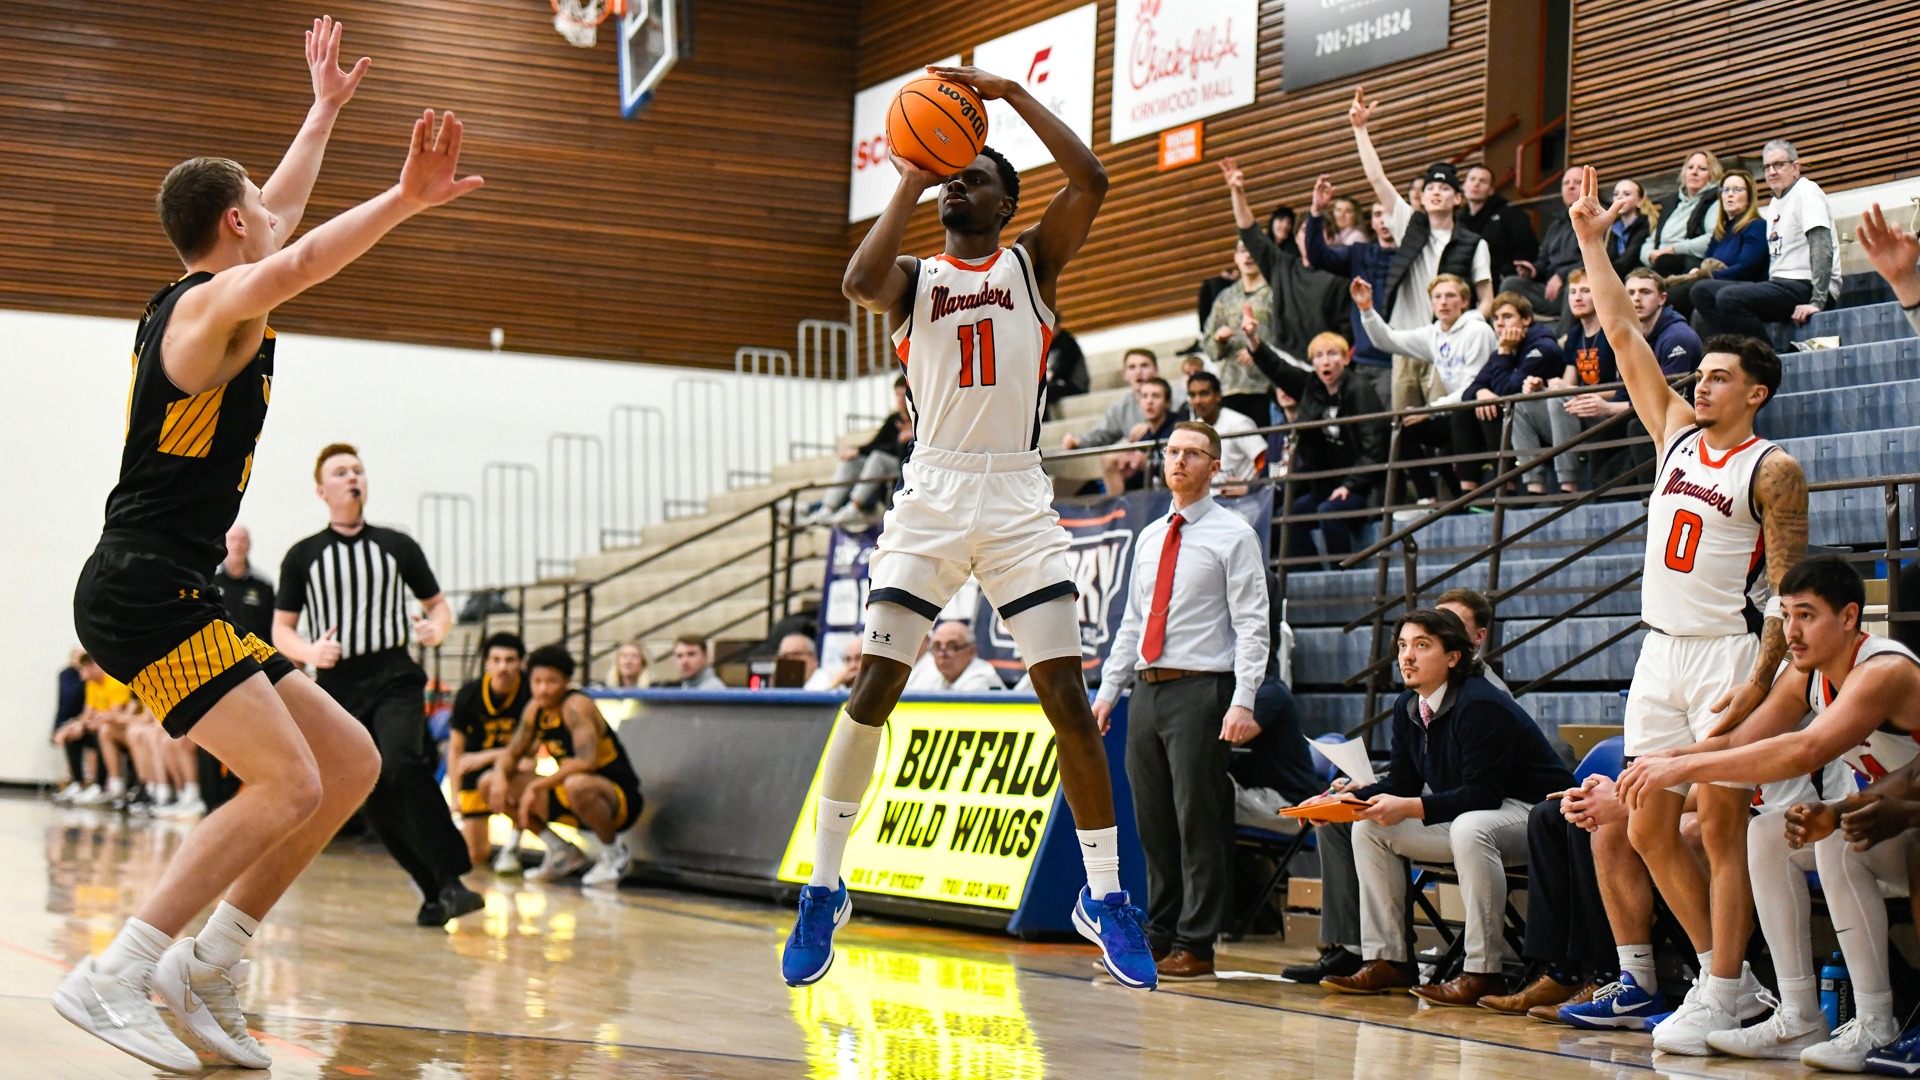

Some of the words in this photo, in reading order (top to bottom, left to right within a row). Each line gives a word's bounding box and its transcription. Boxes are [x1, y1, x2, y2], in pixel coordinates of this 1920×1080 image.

[937, 83, 985, 141] Wilson
[1131, 88, 1198, 122] KIRKWOOD
[1202, 77, 1234, 102] MALL
[931, 281, 1014, 323] Marauders
[957, 318, 996, 388] 11
[1661, 467, 1734, 517] Marauders
[1664, 508, 1703, 574] 0
[895, 729, 1060, 798] BUFFALO
[876, 800, 946, 848] WILD
[950, 805, 1044, 859] WINGS
